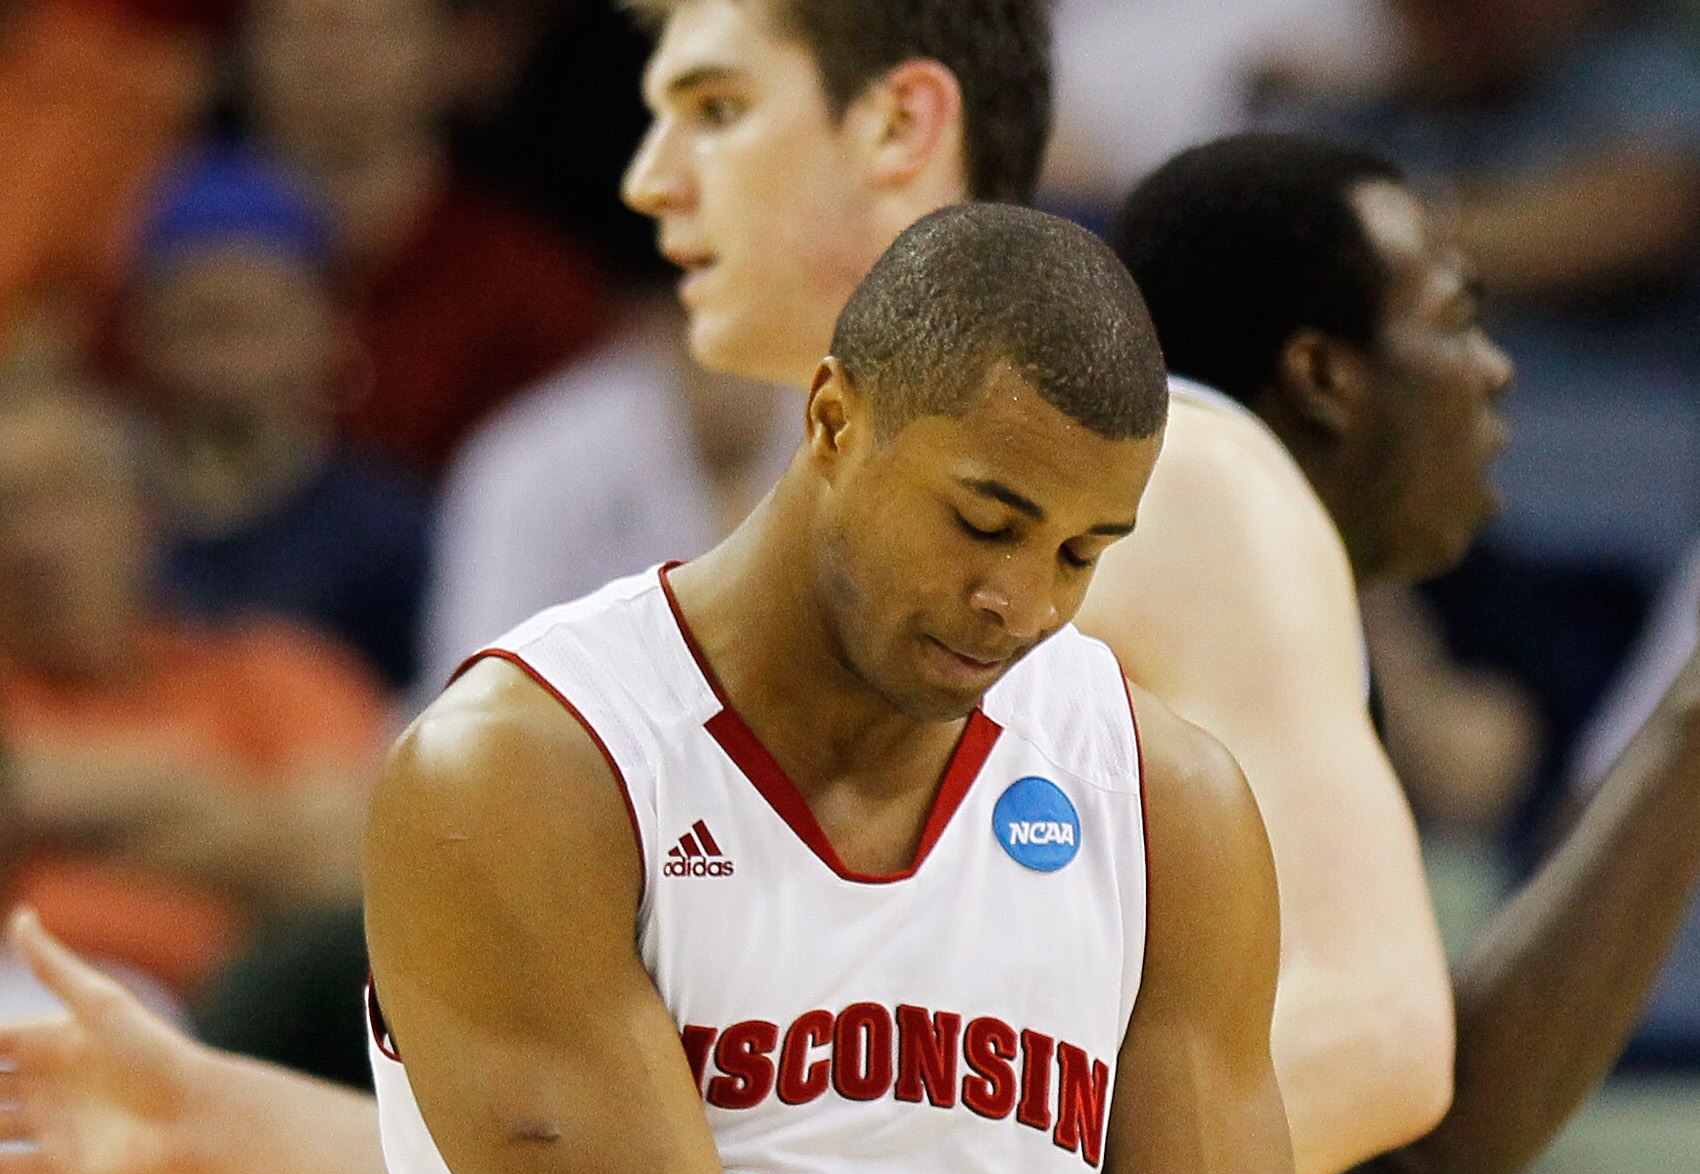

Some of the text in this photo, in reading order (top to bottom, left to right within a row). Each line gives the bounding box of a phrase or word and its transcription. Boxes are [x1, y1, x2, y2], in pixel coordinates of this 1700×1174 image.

[1008, 821, 1075, 846] NCAA
[663, 856, 734, 877] adidas
[680, 1002, 1109, 1168] ISCONSIN
